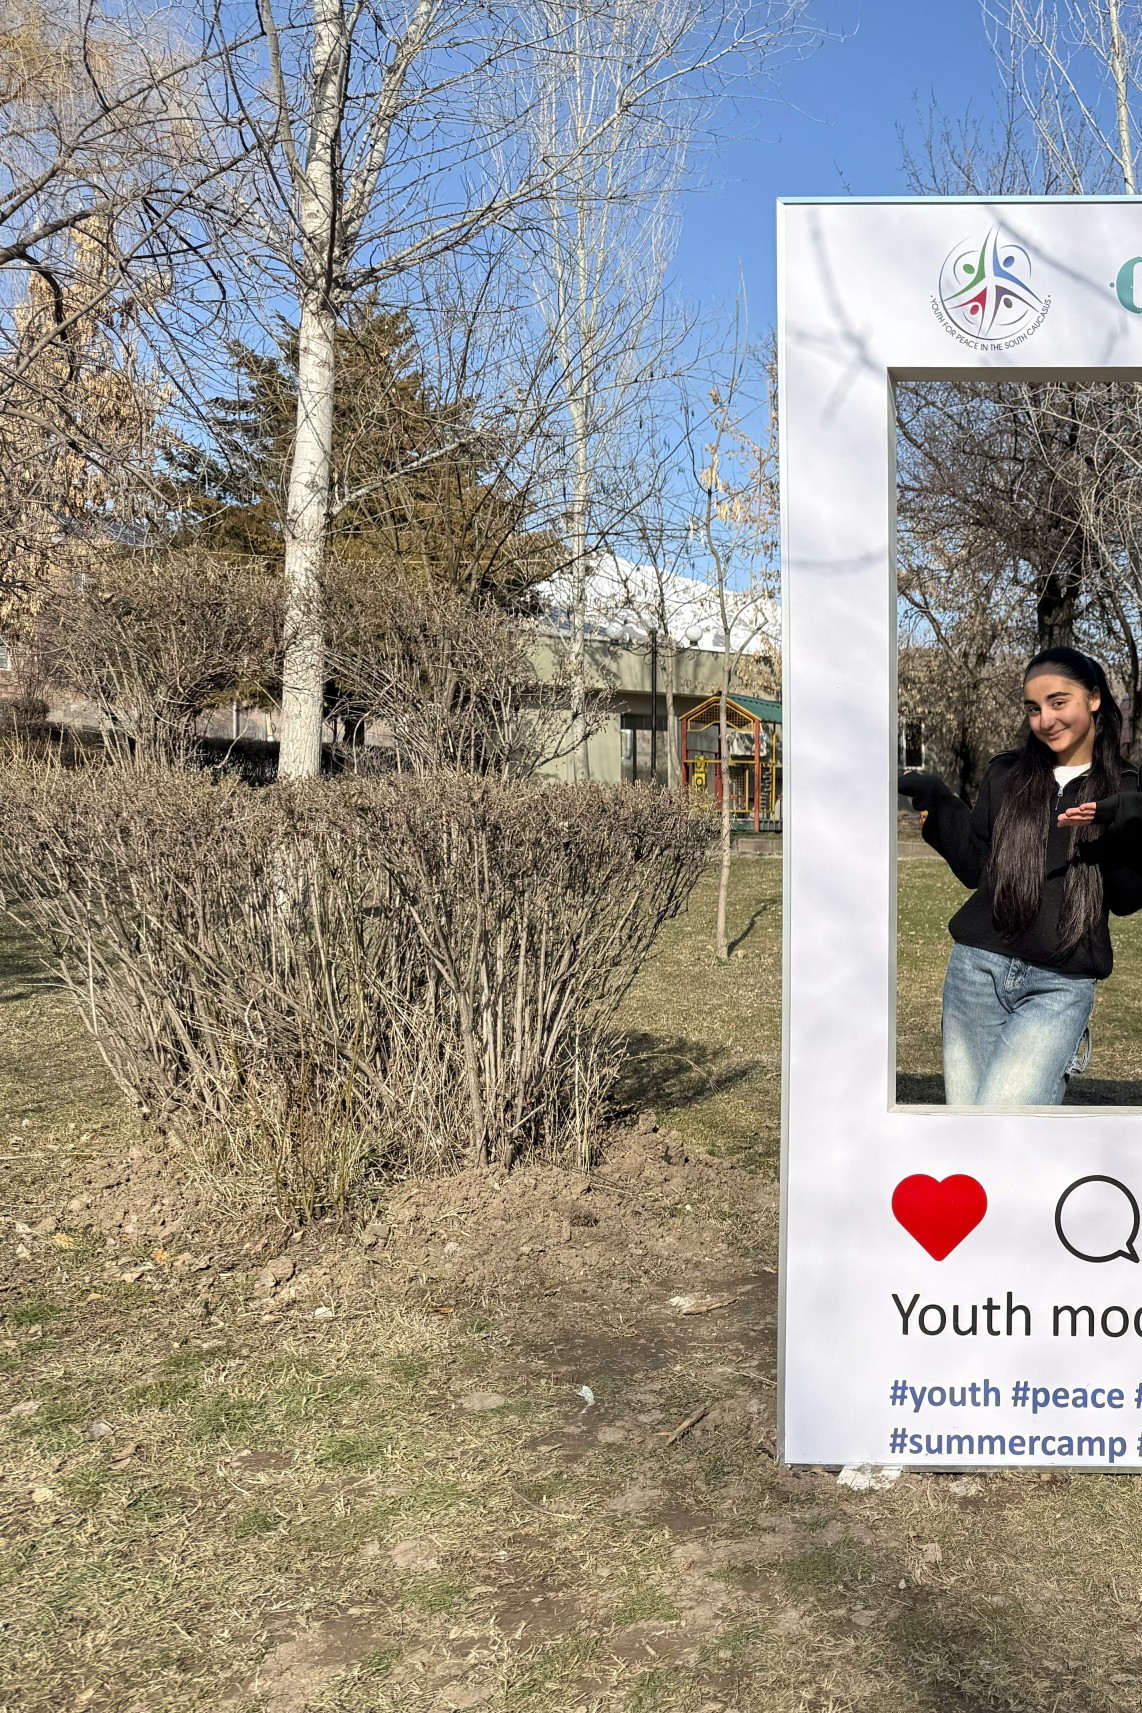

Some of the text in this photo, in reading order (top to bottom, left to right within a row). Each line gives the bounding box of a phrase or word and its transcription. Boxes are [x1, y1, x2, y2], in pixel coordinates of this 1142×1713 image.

[929, 297, 1052, 351] YOUTH FOR PEACE IN THE SOUTH CAUCASUS
[891, 1291, 1032, 1336] Youth
[889, 1379, 1001, 1413] #youth
[1011, 1380, 1125, 1414] #peace
[889, 1427, 1127, 1464] #summercamp
